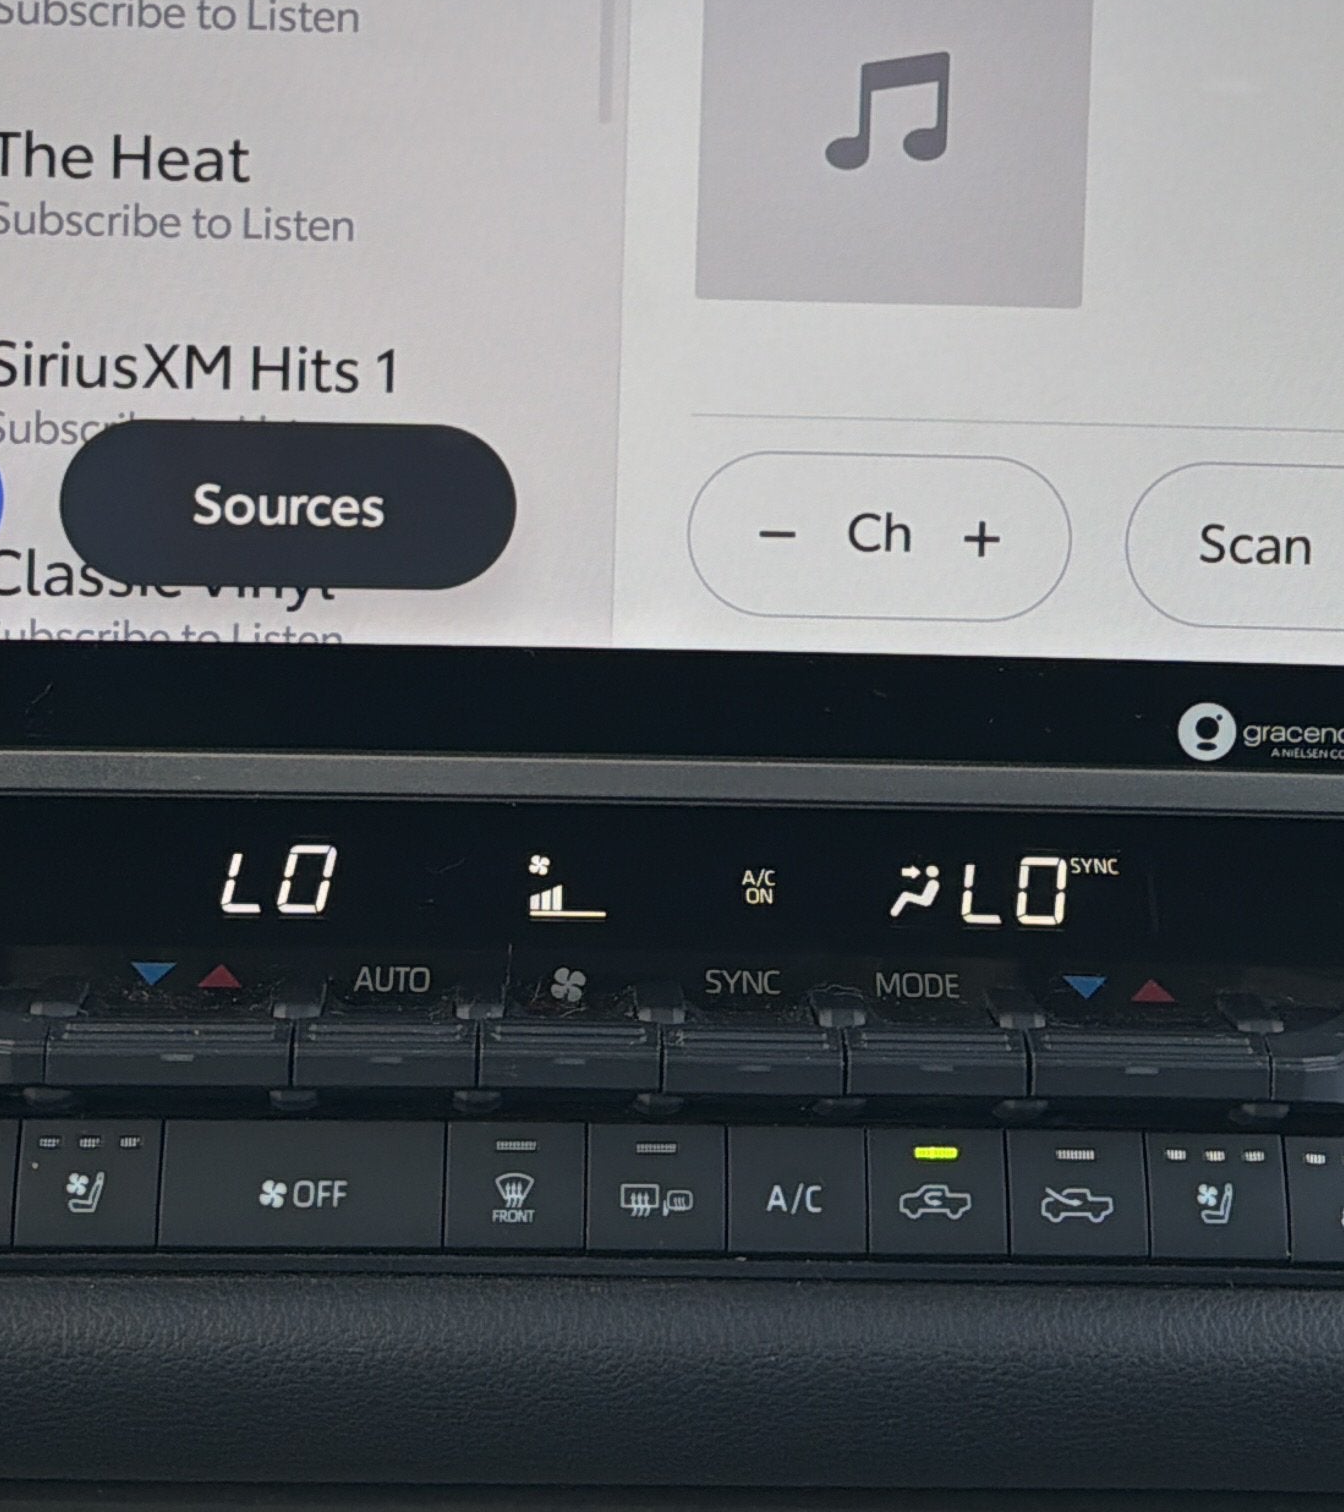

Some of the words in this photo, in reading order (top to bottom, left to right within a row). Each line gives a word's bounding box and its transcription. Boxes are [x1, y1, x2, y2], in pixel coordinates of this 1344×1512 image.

[196, 0, 237, 31] to
[112, 133, 251, 184] Heat
[191, 208, 232, 240] to
[243, 206, 355, 242] Listen
[251, 345, 359, 394] Hits
[377, 348, 396, 394] 1
[193, 482, 385, 528] Sources
[848, 511, 911, 553] Ch
[1199, 523, 1312, 565] Scan
[1270, 747, 1280, 757] A
[220, 844, 338, 914] LO
[741, 868, 776, 887] A/C
[1070, 857, 1119, 876] SYNC
[745, 887, 774, 905] ON
[961, 856, 1067, 926] LO
[353, 966, 431, 993] AUTO
[705, 969, 781, 995] SYNC
[875, 972, 960, 999] MODE
[292, 1180, 348, 1208] OFF
[766, 1182, 823, 1215] A/C
[492, 1209, 536, 1223] FRONT
